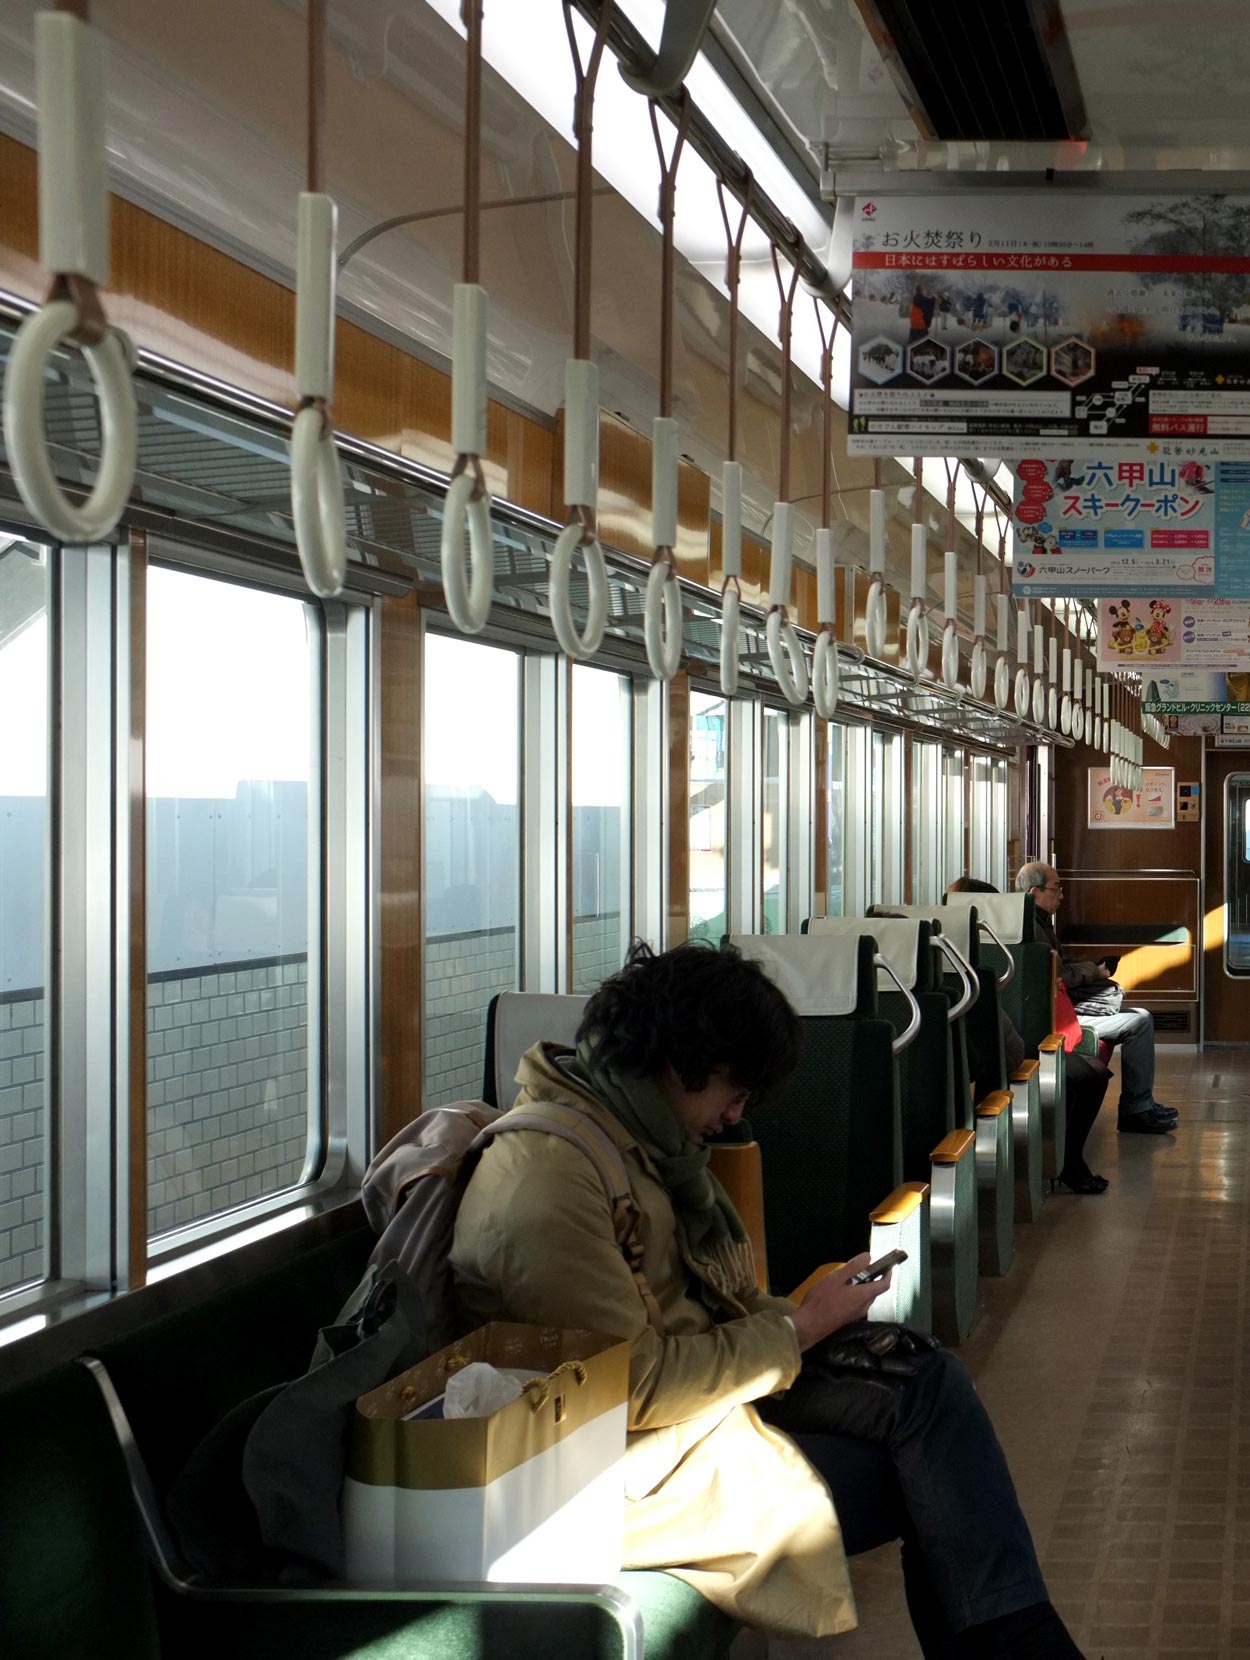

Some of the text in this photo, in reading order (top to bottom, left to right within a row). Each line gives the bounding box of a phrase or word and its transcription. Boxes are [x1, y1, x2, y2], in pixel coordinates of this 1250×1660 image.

[882, 230, 983, 250] お火焚祭り
[884, 254, 1073, 269] 日本にはすばらしい文化がある
[1086, 461, 1176, 488] 六甲山
[1062, 493, 1200, 517] スキークーポン
[1039, 562, 1111, 575] 六甲山スノーパーク
